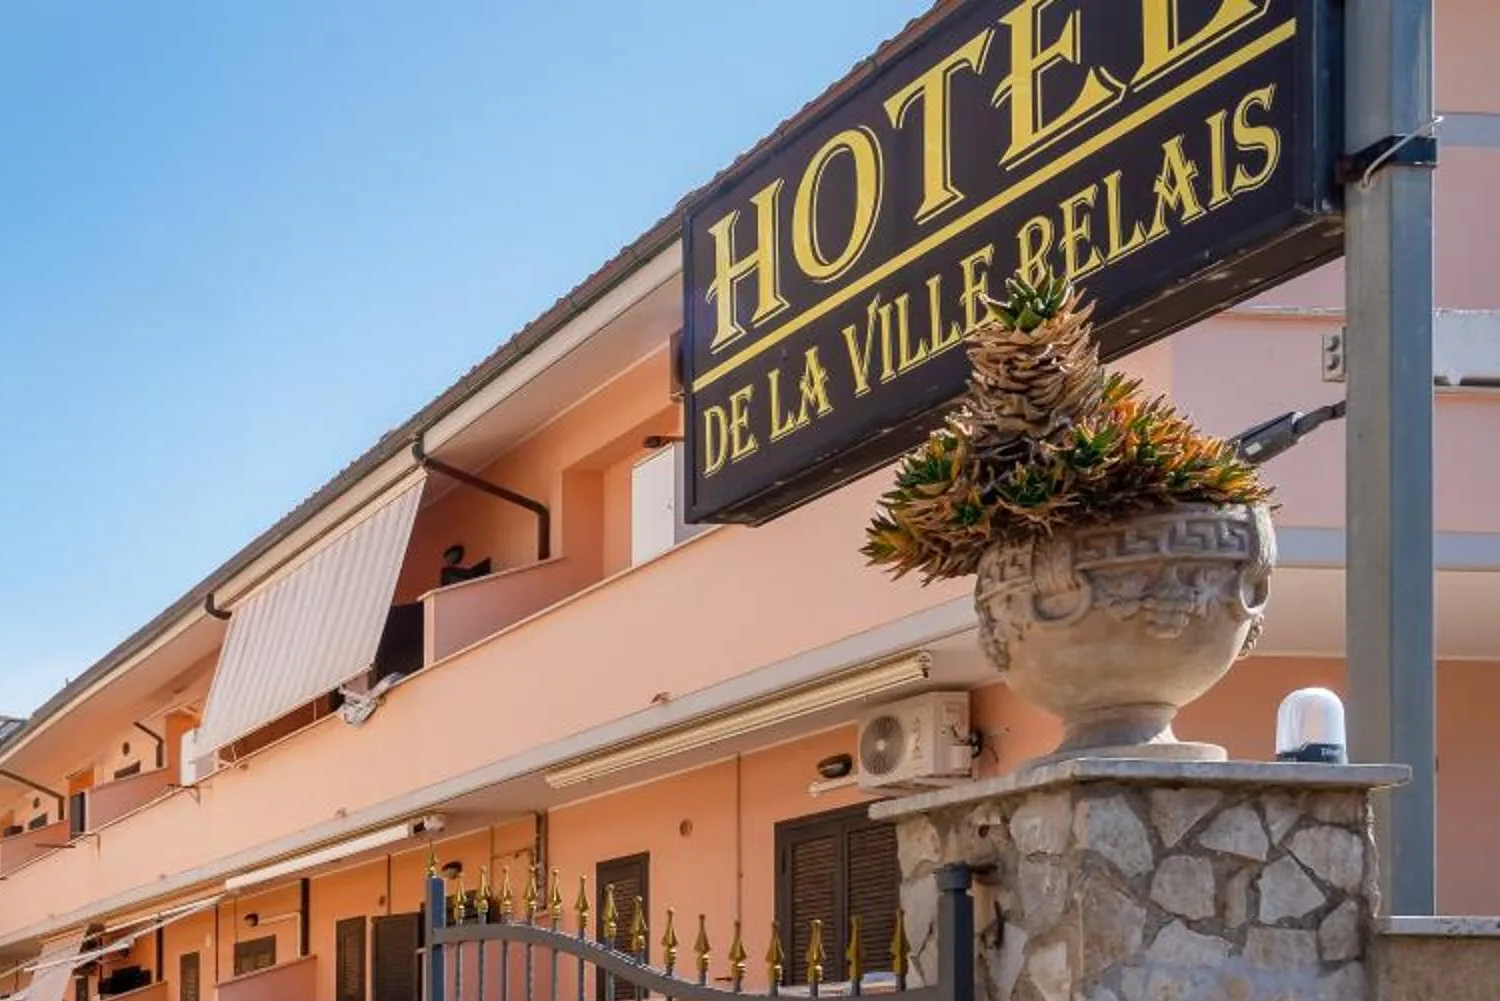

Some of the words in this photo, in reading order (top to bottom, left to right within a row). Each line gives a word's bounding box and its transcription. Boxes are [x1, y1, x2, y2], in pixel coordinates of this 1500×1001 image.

[703, 383, 758, 479] DE
[767, 345, 834, 442] LA
[842, 243, 1000, 398] VILLE
[1013, 82, 1281, 290] RELAIS
[706, 0, 1272, 355] HOTEL
